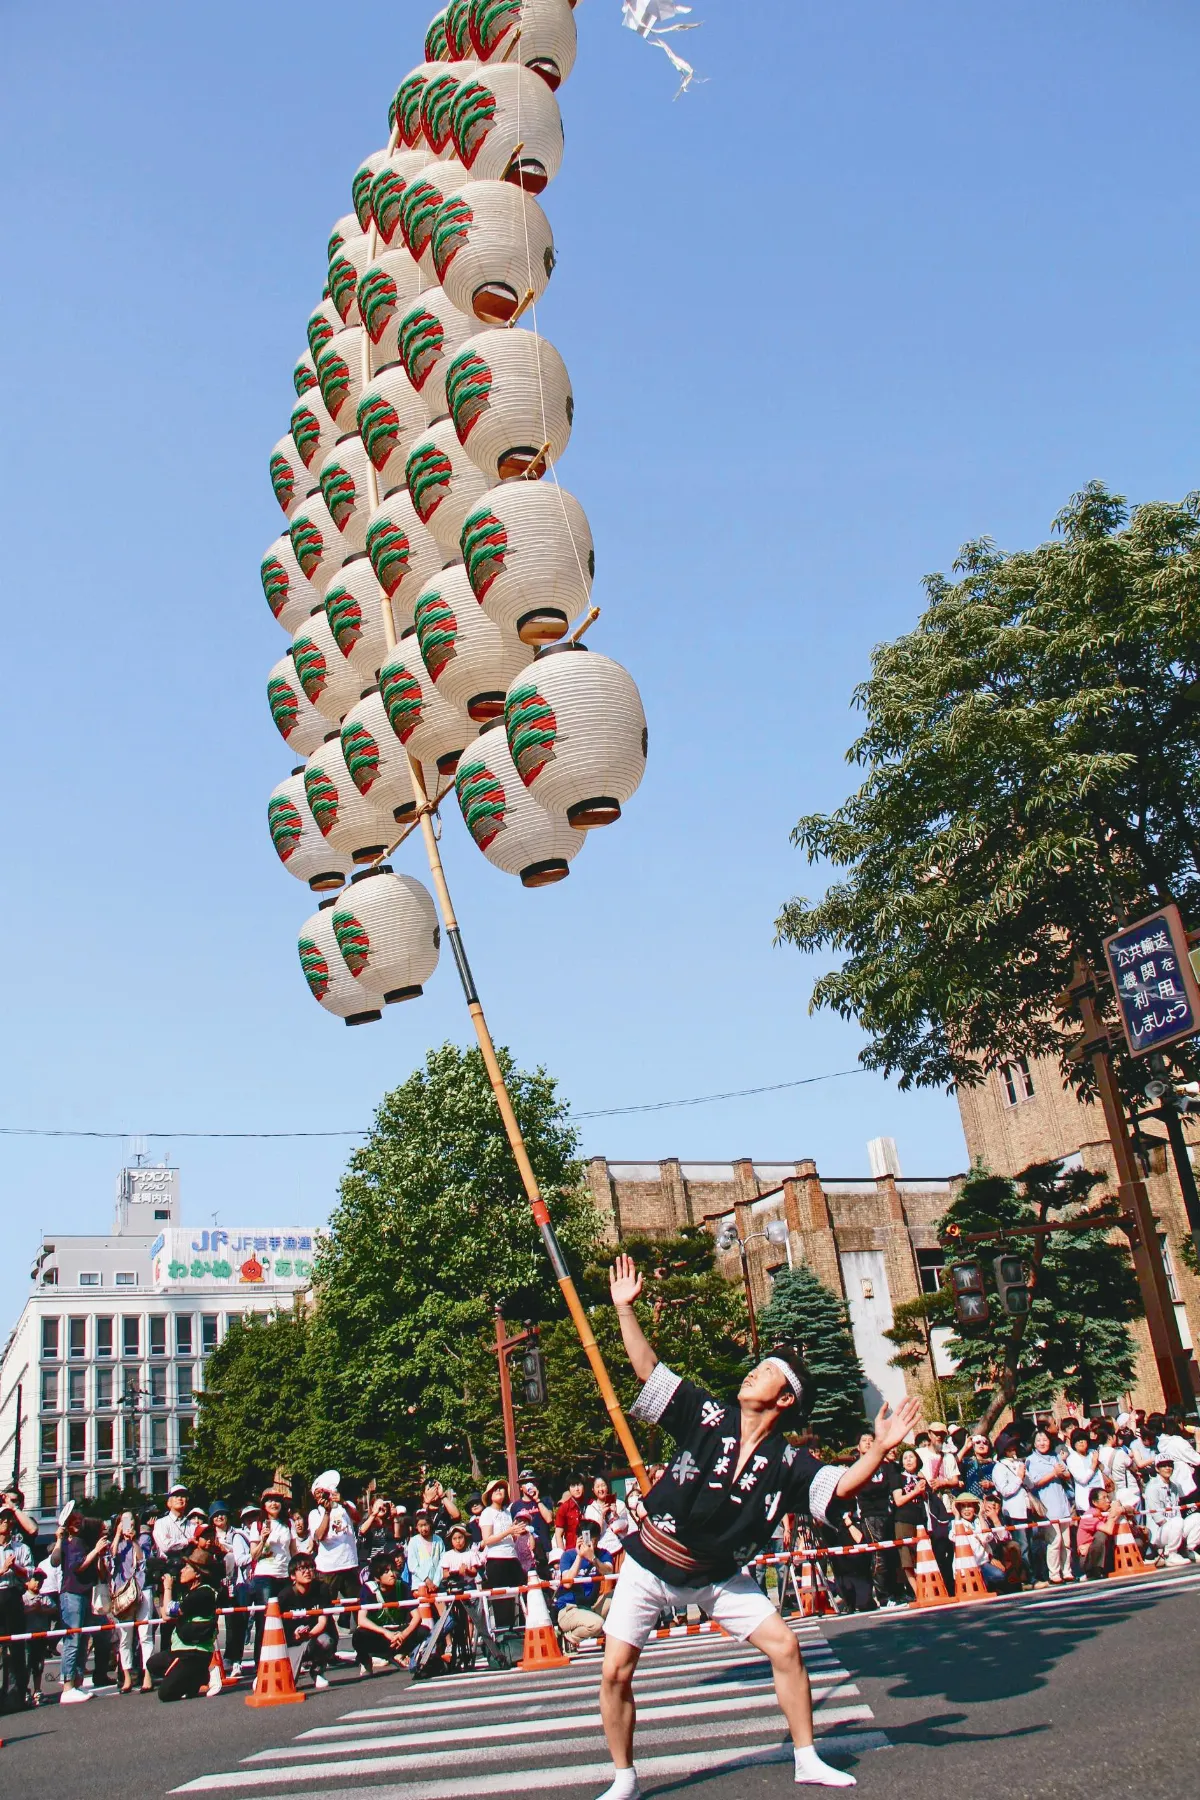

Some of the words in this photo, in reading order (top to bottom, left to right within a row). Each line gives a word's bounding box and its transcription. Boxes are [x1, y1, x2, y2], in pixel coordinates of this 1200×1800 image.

[1117, 930, 1169, 968] 公共輸送
[1122, 957, 1175, 990] 機関を
[1133, 978, 1176, 1010] 利用
[1131, 1000, 1188, 1037] しましょう
[168, 1259, 233, 1279] わかめ
[708, 1436, 737, 1489] 下米一
[730, 1454, 769, 1504] 下米一
